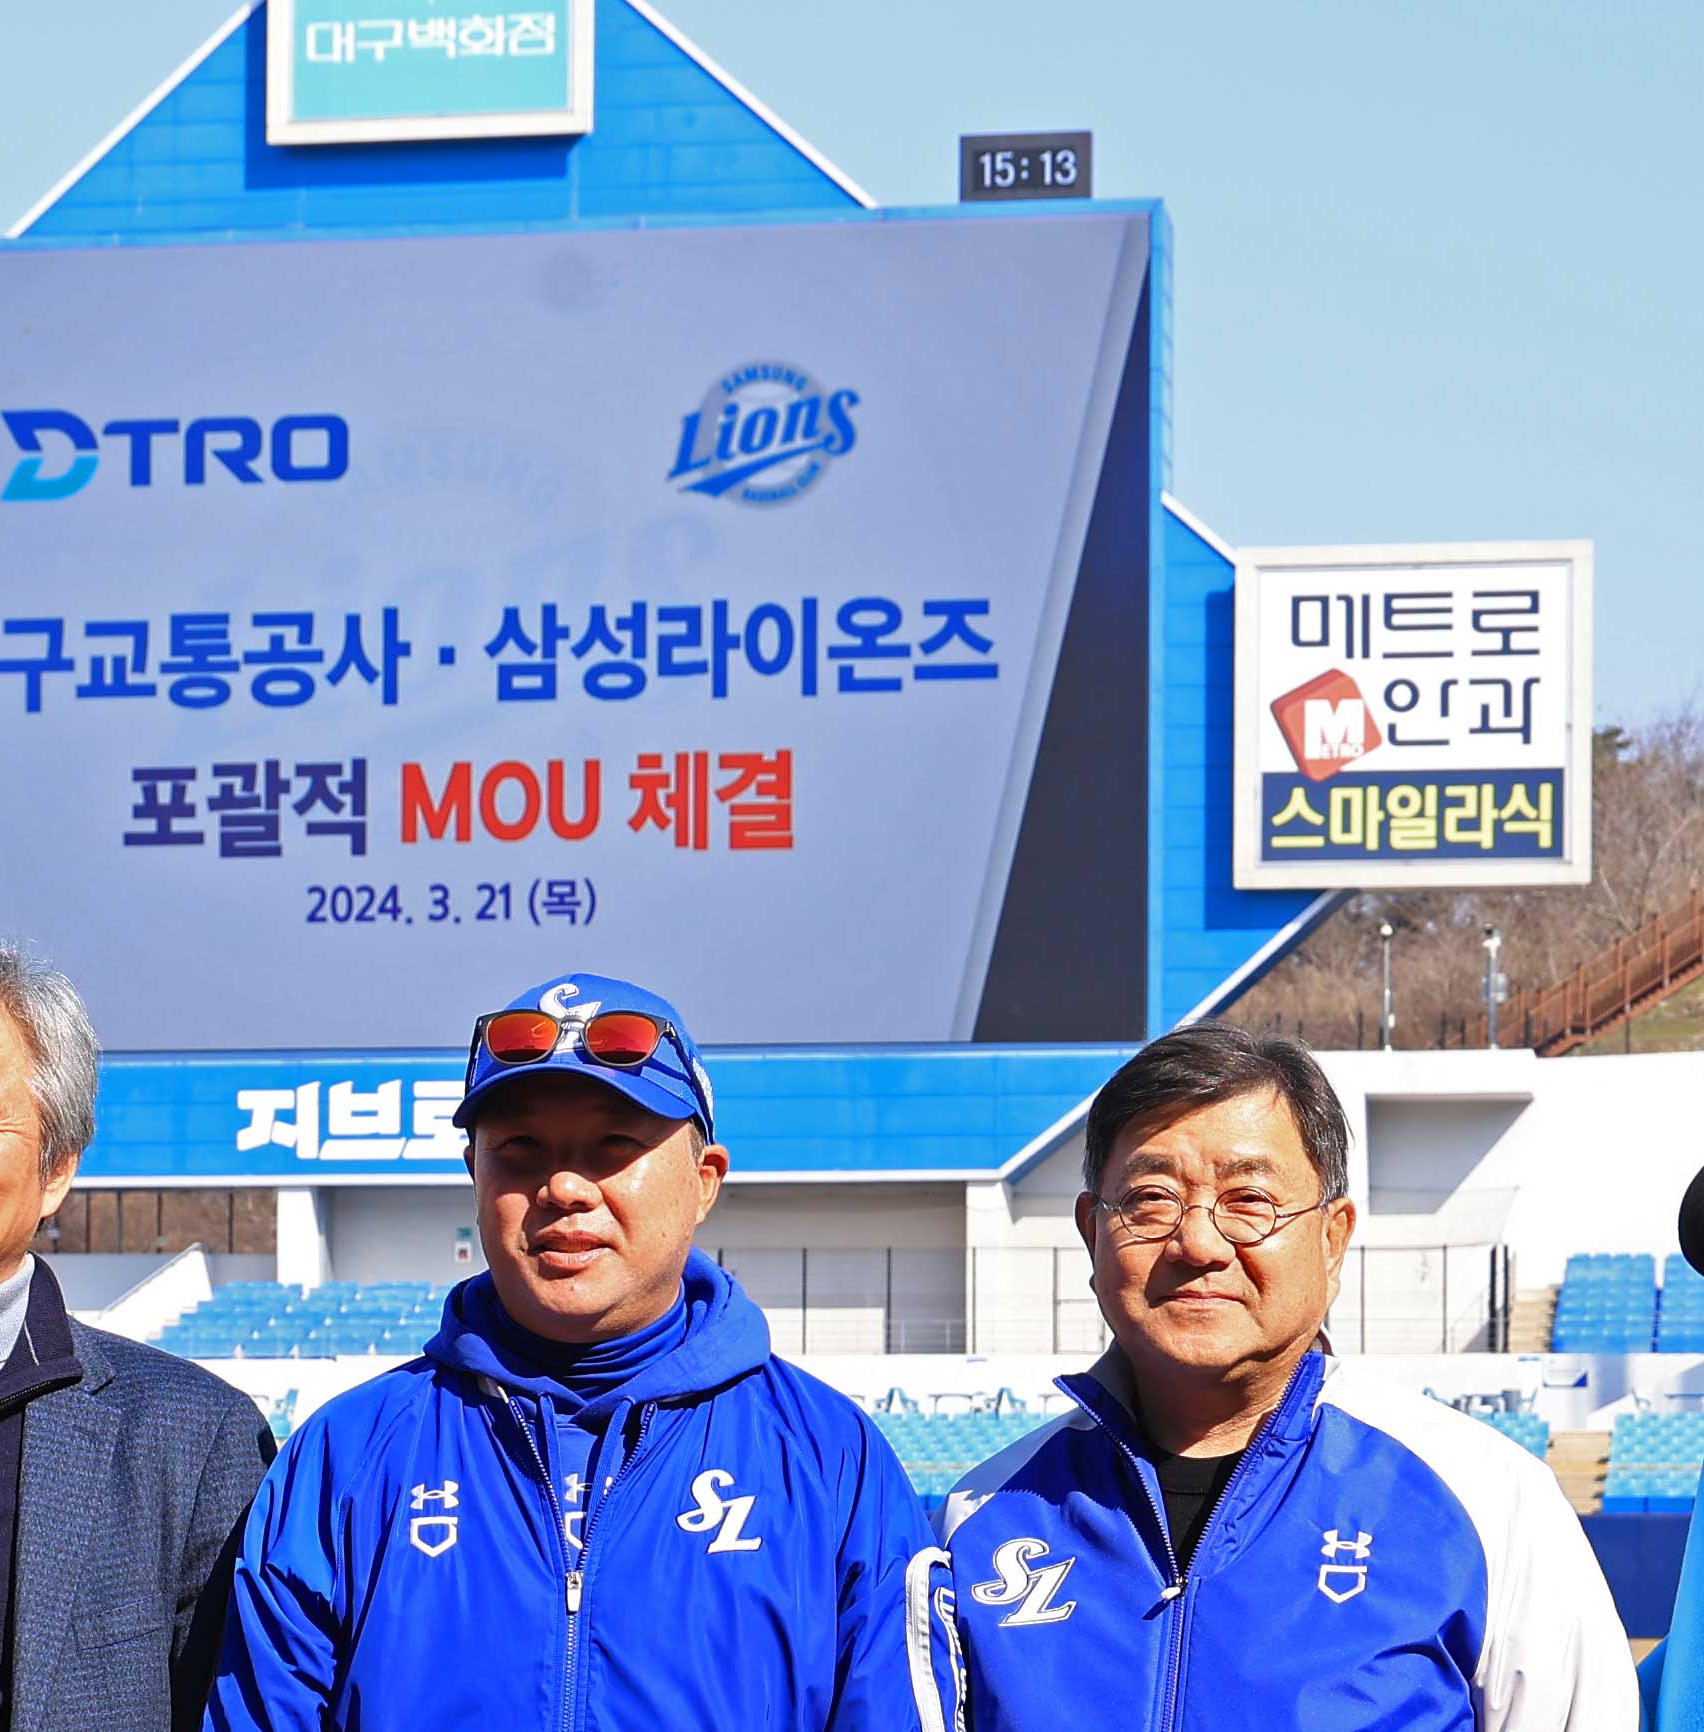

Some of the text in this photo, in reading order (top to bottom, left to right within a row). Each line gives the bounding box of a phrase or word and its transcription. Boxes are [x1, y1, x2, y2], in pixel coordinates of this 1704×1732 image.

[305, 12, 556, 64] 대구백화점
[979, 150, 1077, 188] 15:13
[0, 409, 349, 502] DTRO
[666, 388, 860, 498] Lions
[483, 596, 1000, 702] 삼성라이온즈
[1291, 590, 1540, 659] 메트로
[1383, 677, 1541, 746] 안과
[123, 750, 793, 857] 포괄적 MOU 체결
[1270, 783, 1553, 851] 스마일라식
[306, 878, 597, 926] 2024. 3. 21 (목)
